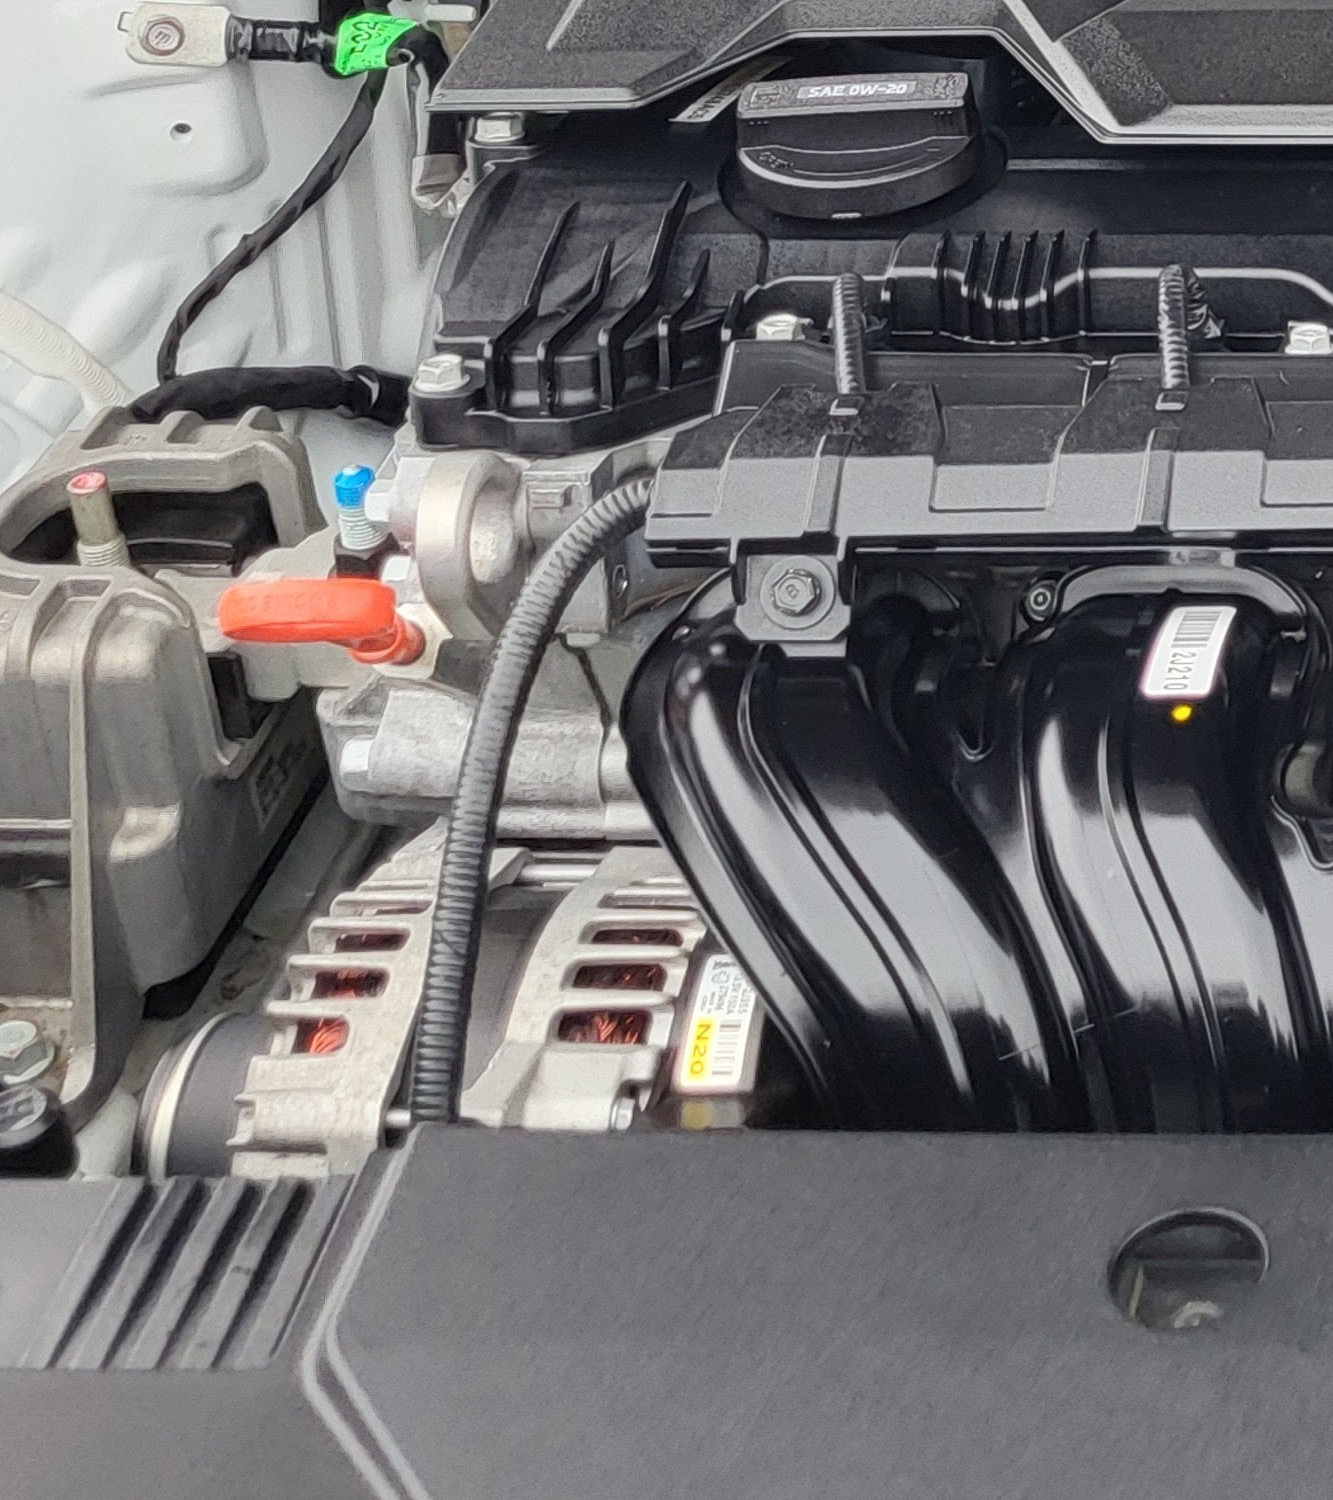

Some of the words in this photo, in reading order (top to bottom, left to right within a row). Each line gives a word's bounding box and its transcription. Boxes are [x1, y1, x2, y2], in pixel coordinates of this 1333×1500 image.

[808, 85, 846, 98] SAE
[849, 83, 909, 97] 0W-20
[1163, 651, 1196, 691] 2J210
